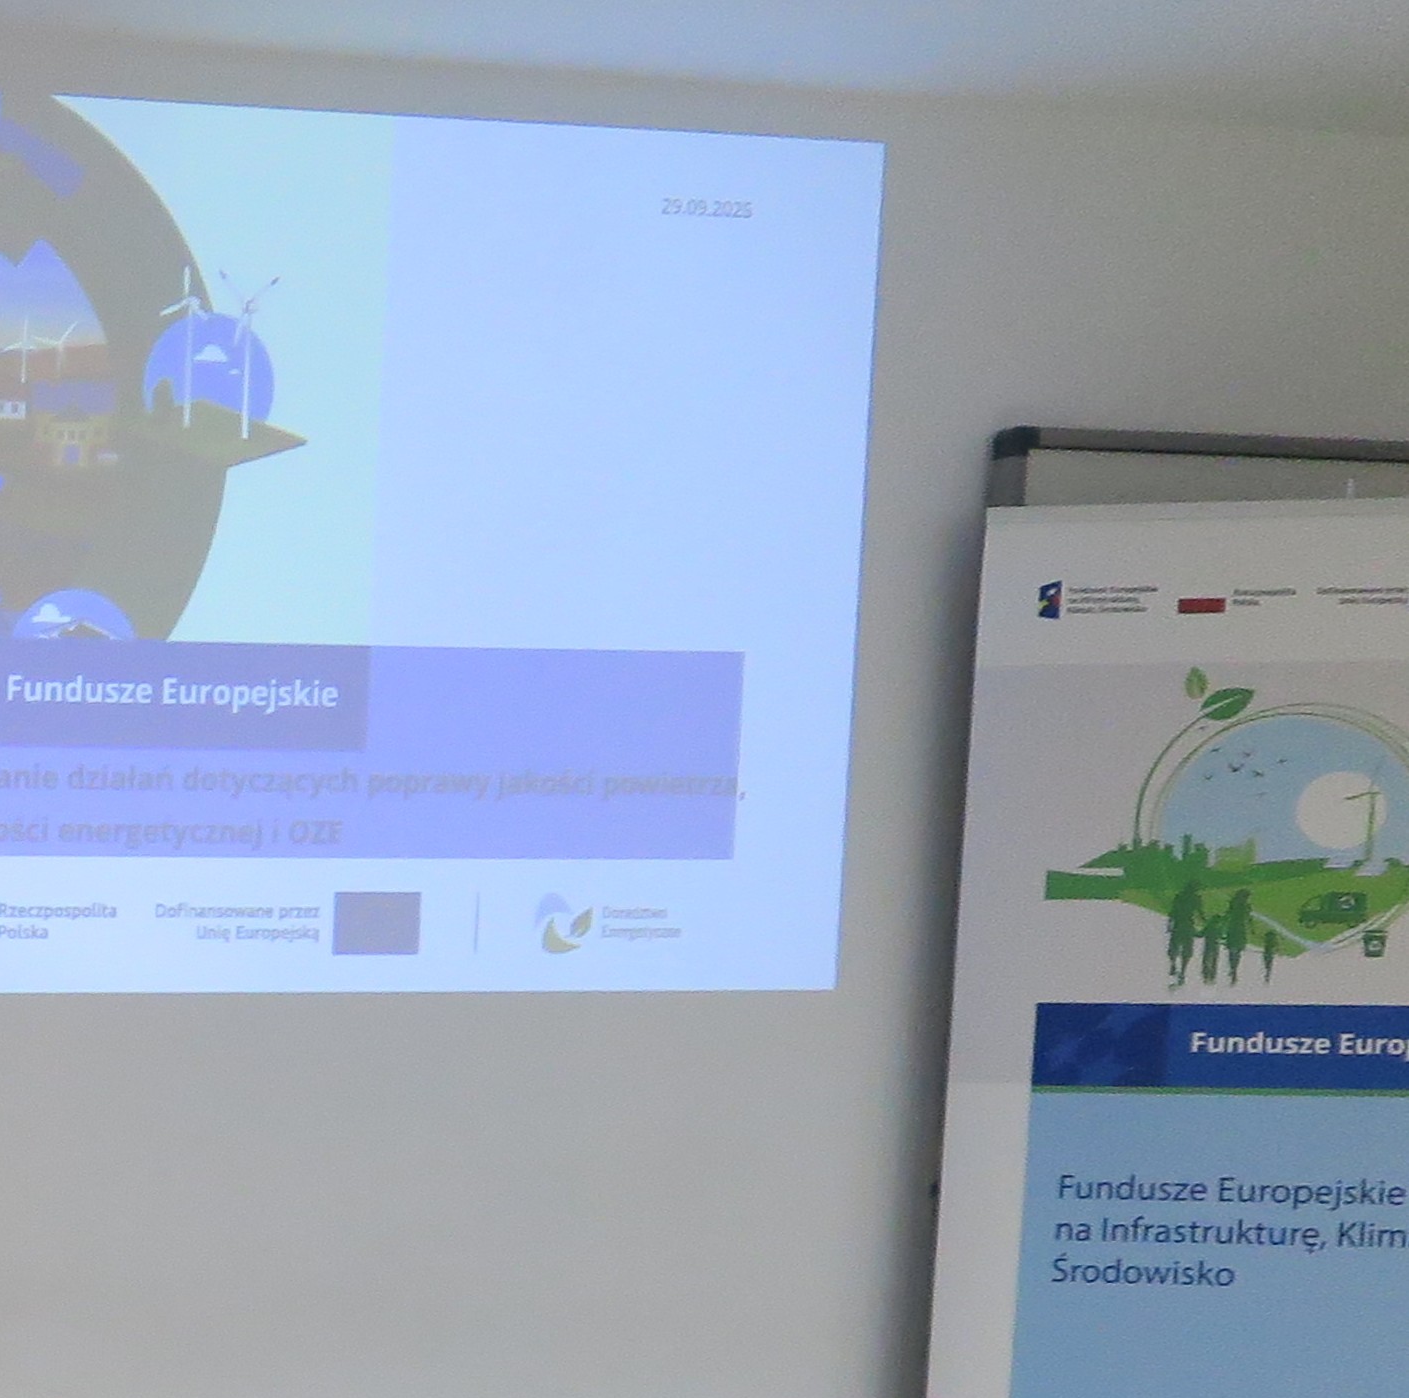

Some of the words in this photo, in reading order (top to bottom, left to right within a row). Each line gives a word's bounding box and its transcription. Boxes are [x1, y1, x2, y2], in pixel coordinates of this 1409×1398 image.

[662, 197, 753, 219] 29.09.2025
[6, 673, 153, 704] Fundusze
[162, 677, 339, 714] Europejskie
[68, 763, 174, 791] działań
[183, 765, 360, 799] dotyczących
[367, 771, 489, 801] poprawy
[57, 818, 263, 849] energetycznej
[272, 819, 280, 843] i
[288, 820, 344, 846] OZE
[155, 903, 273, 918] Dofinansowane
[197, 924, 231, 942] Unię
[236, 924, 320, 942] Europejską
[1190, 1031, 1331, 1055] Fundusze
[1339, 1033, 1409, 1062] Euro
[1058, 1173, 1208, 1201] Fundusze
[1218, 1177, 1408, 1212] Europejskie
[1055, 1221, 1091, 1242] na
[1101, 1216, 1327, 1254] Infrastrukturę,
[1338, 1220, 1409, 1249] Klim
[1051, 1252, 1236, 1287] Środowisko
